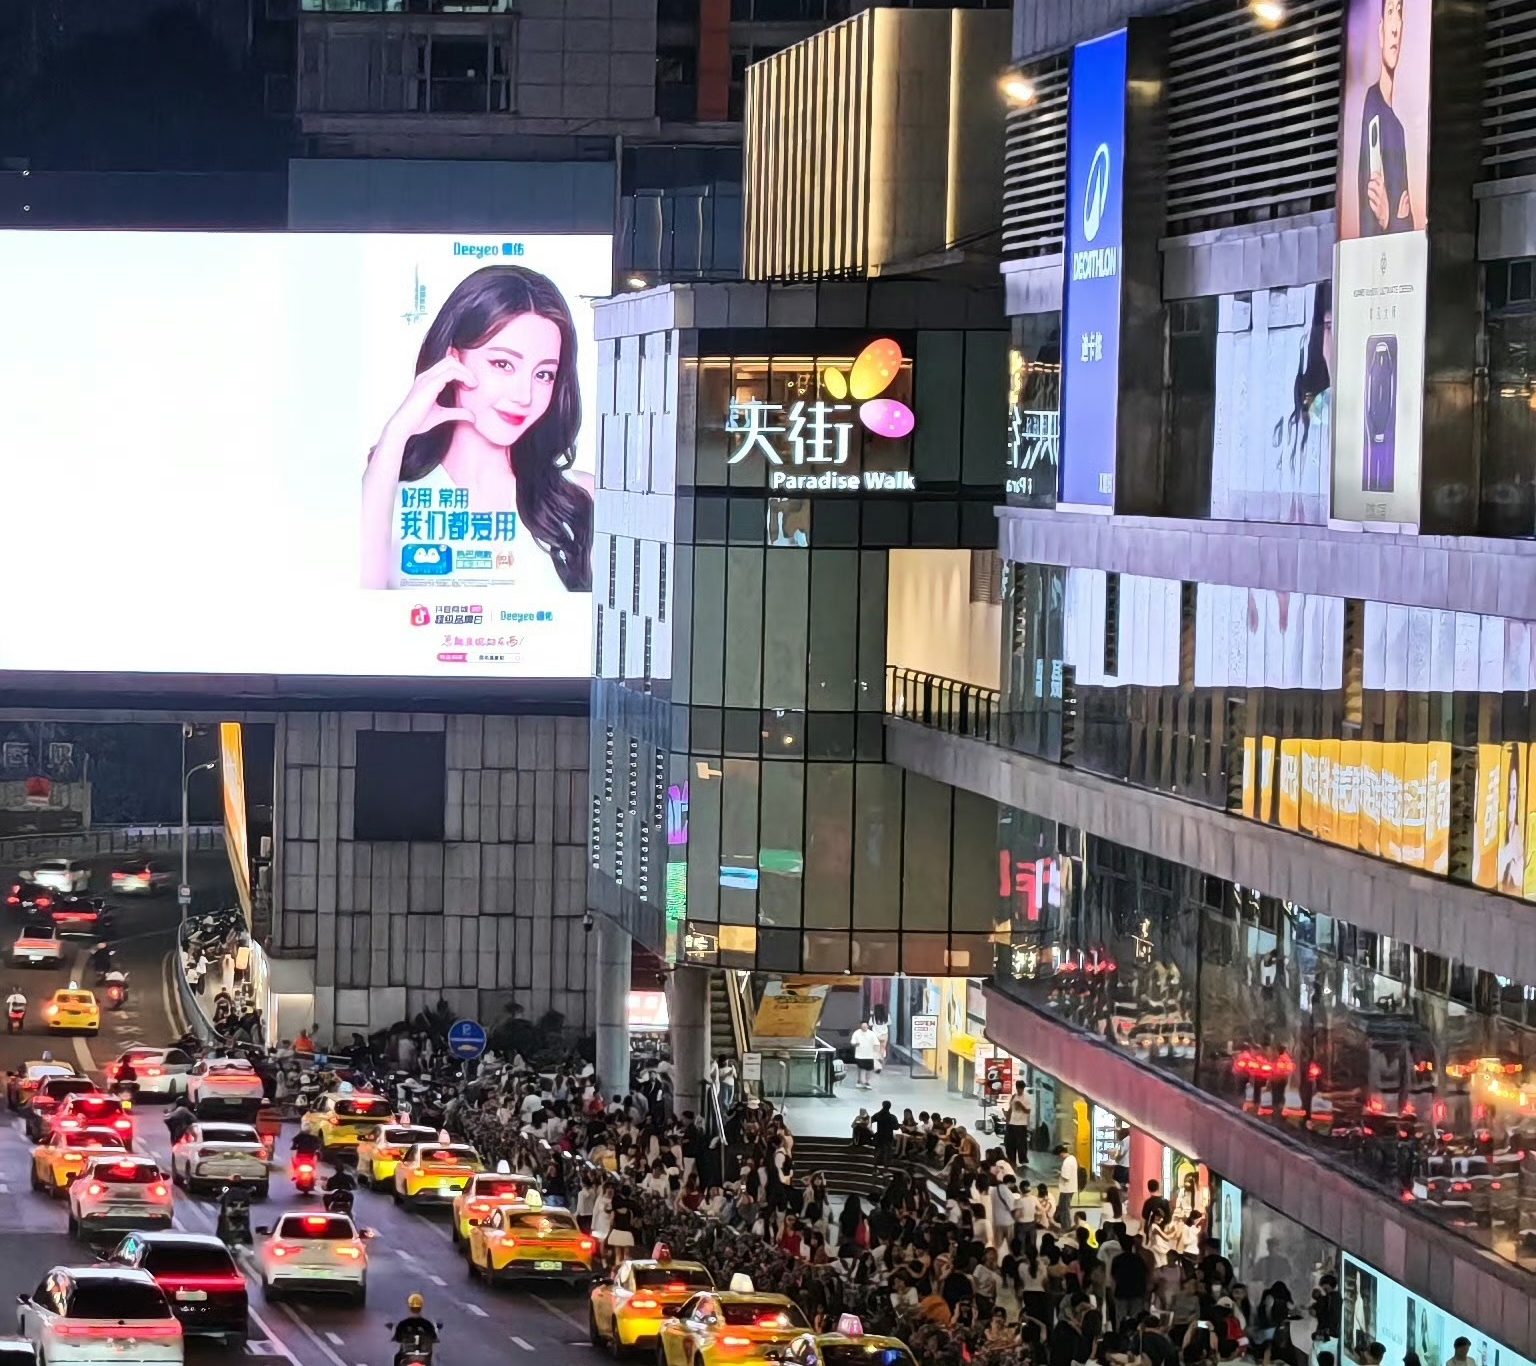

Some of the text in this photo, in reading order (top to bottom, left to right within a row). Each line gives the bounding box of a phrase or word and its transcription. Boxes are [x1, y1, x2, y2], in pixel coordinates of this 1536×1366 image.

[454, 242, 499, 259] Deeyeo
[1073, 247, 1117, 282] DECATHLON
[727, 400, 853, 466] 天街
[772, 471, 916, 490] Paradise Walk
[401, 487, 469, 509] 好用 常用
[401, 510, 517, 541] 我们都爱用
[500, 611, 534, 622] Deeyeo
